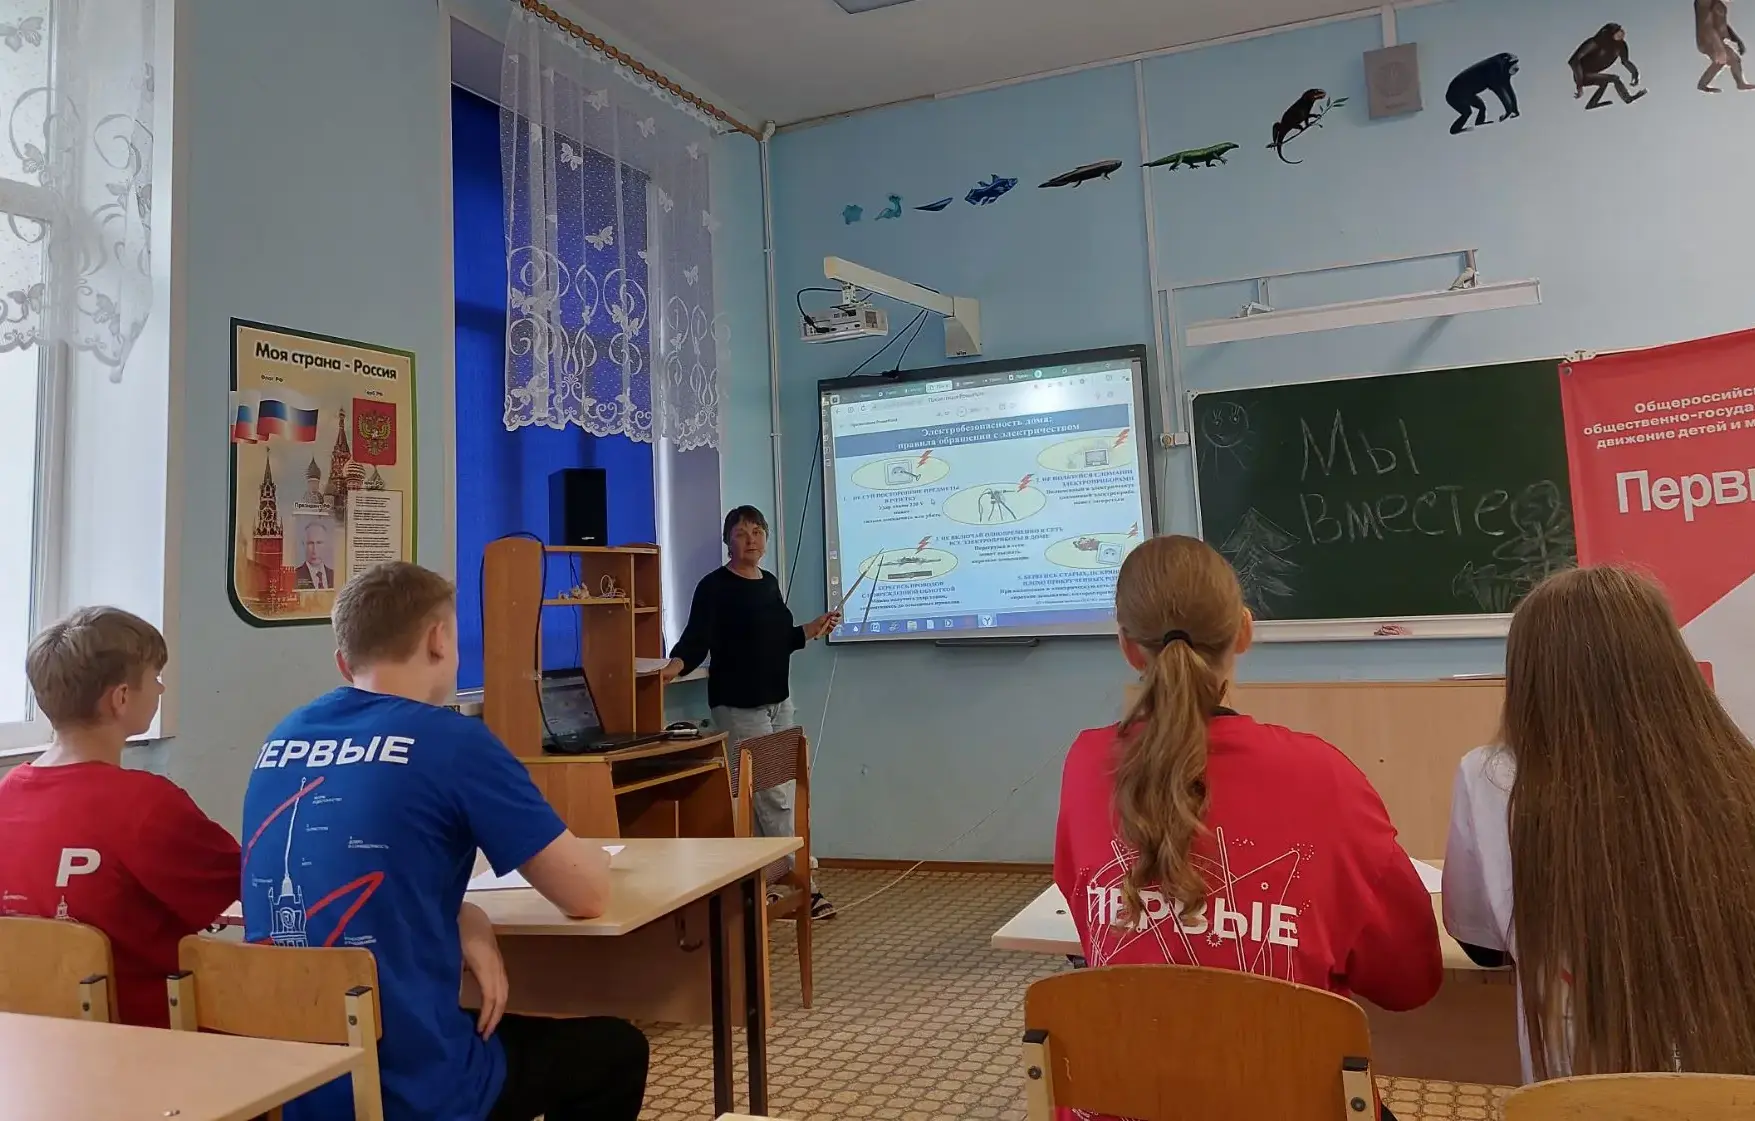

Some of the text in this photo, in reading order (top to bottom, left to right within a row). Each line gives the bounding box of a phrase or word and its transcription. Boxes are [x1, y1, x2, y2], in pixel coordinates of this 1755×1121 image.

[255, 342, 288, 361] Моя
[292, 352, 341, 370] страна
[354, 359, 397, 380] Россия
[1634, 387, 1755, 414] Общероссийс
[898, 438, 936, 450] правила
[938, 433, 991, 446] обращения
[1000, 424, 1080, 439] электричеством
[922, 416, 1053, 438] Электробезопасность дома:
[1596, 429, 1676, 450] движение
[1678, 420, 1727, 438] детей
[1730, 420, 1741, 430] и
